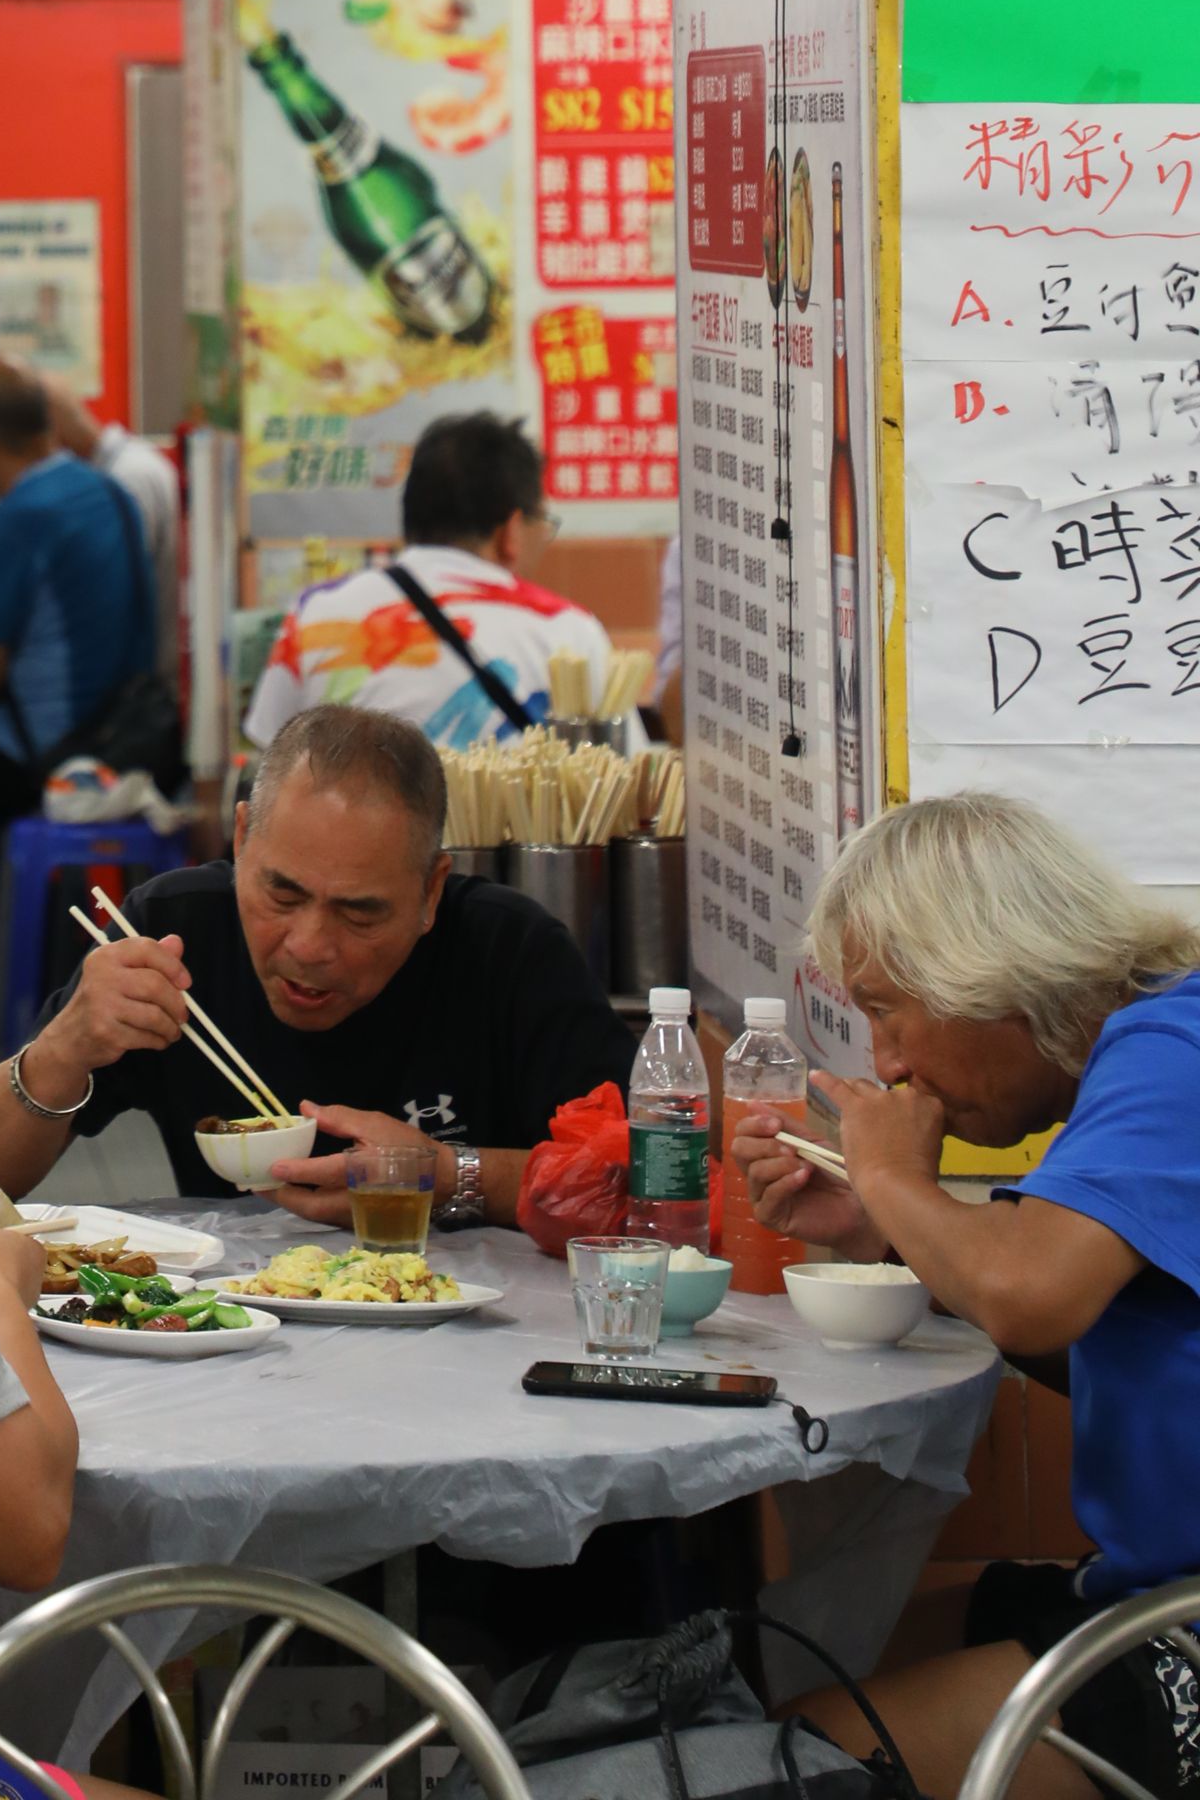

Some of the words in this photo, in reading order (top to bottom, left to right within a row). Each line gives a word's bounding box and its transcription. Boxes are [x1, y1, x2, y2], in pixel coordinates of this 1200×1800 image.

[962, 511, 1023, 581] C
[987, 625, 1043, 716] D
[243, 1771, 332, 1788] IMPORTED
